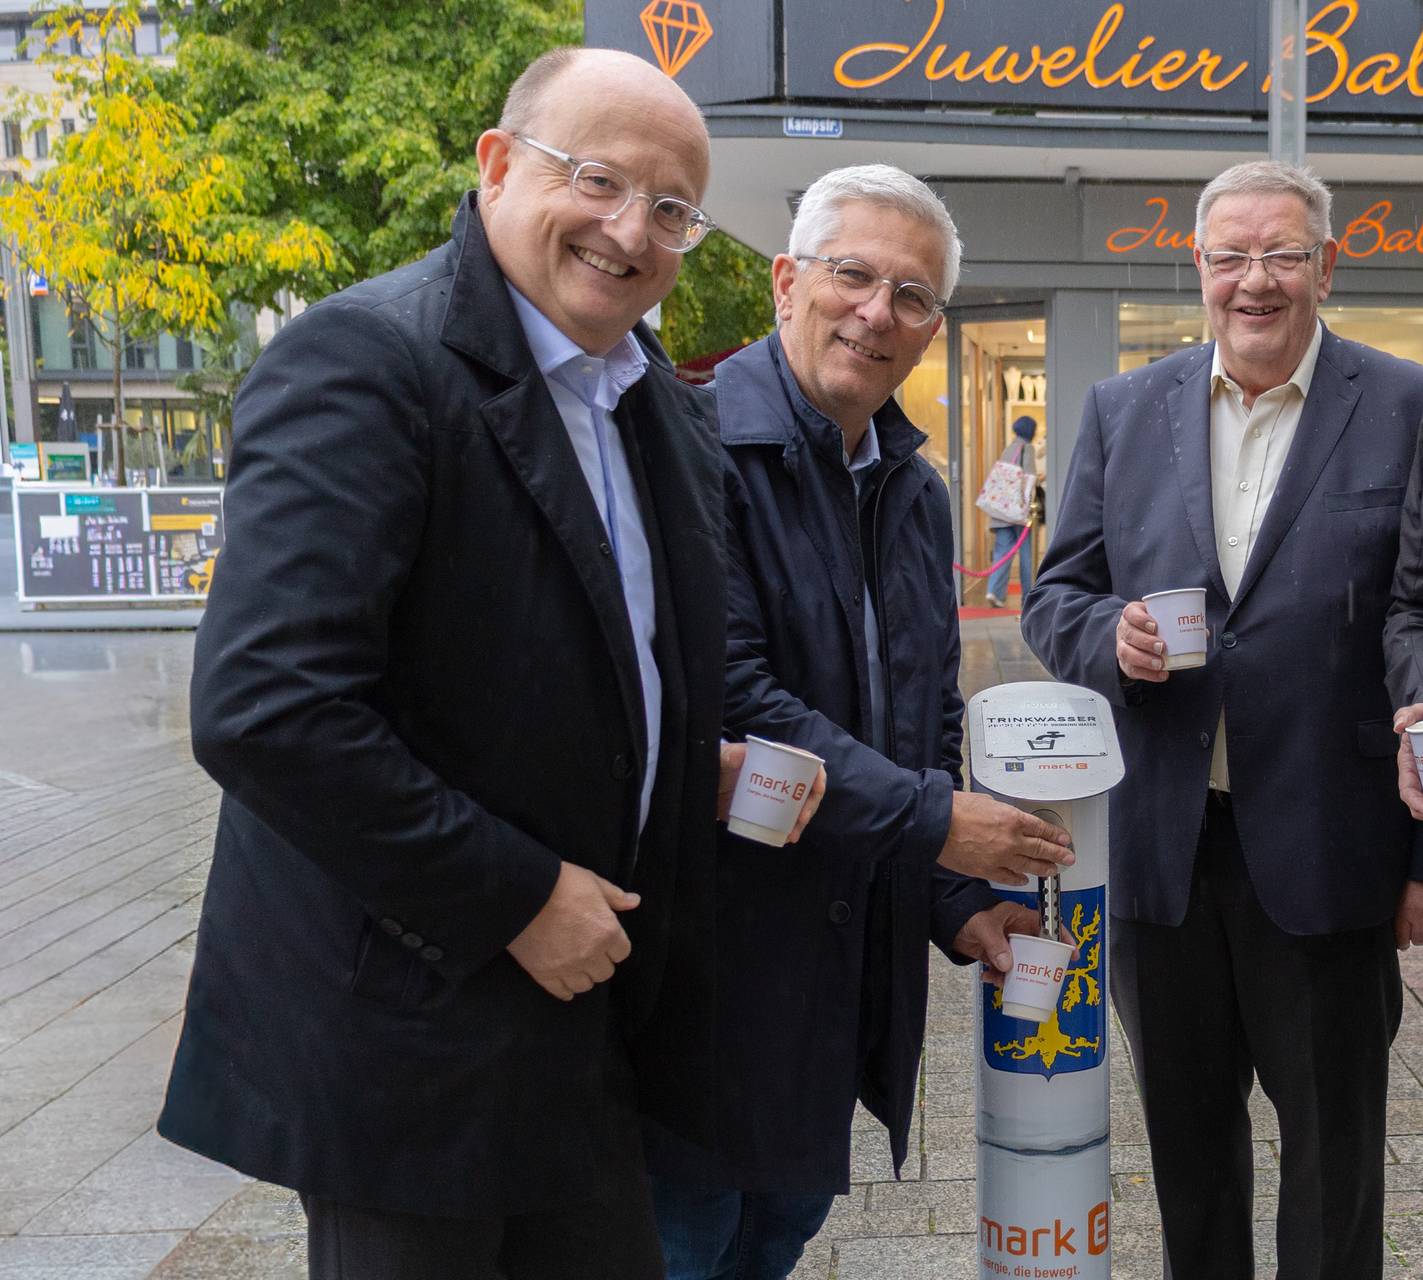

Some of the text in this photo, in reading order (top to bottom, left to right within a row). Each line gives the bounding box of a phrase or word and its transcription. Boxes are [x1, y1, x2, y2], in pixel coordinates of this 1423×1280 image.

[833, 0, 1249, 91] Juwelier
[787, 116, 839, 135] Kampstr.
[1108, 196, 1195, 253] Ju
[1038, 762, 1072, 770] mark
[750, 772, 791, 795] mark
[1017, 963, 1051, 979] mark
[980, 1215, 1076, 1257] mark
[1013, 1265, 1031, 1277] die
[1034, 1265, 1081, 1279] bewegt.
